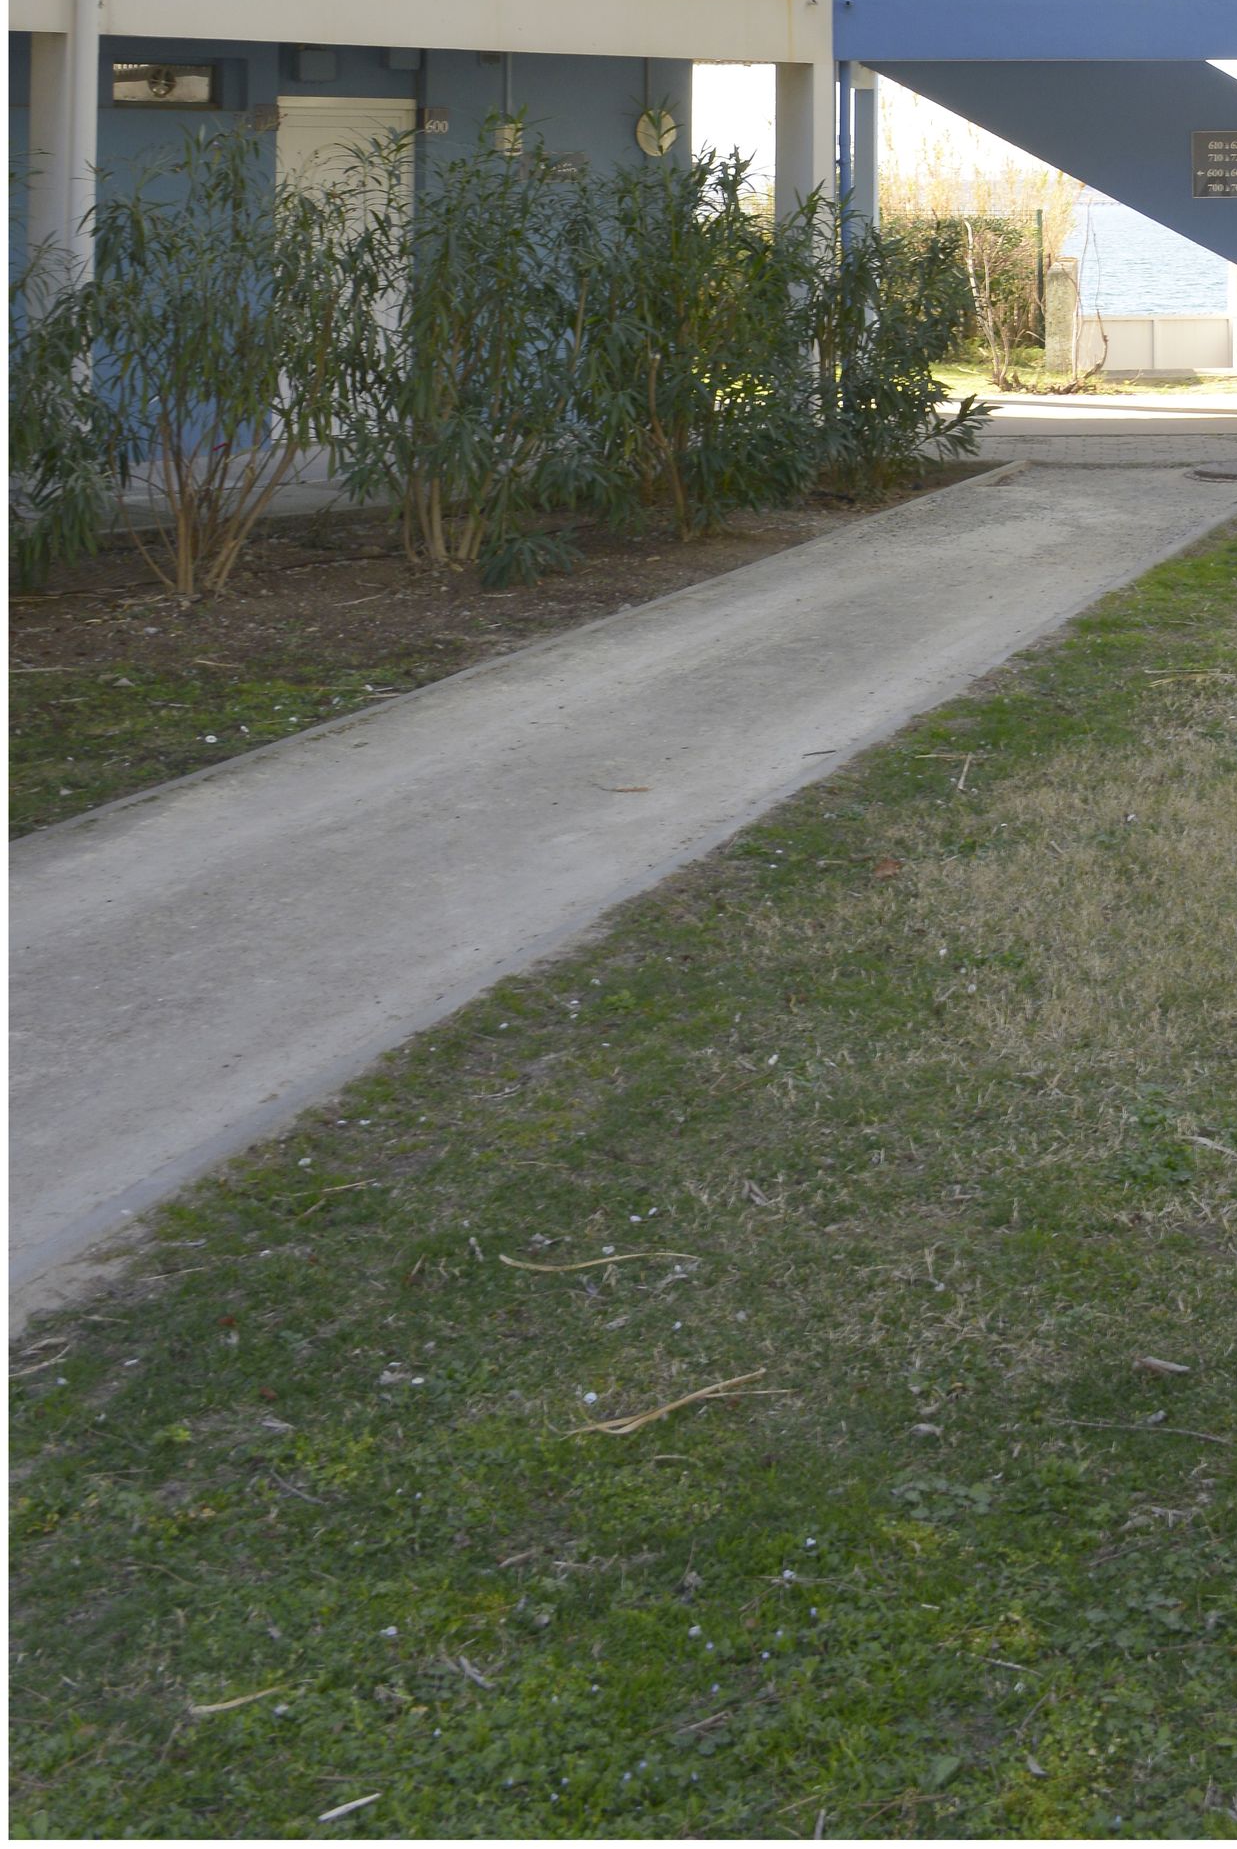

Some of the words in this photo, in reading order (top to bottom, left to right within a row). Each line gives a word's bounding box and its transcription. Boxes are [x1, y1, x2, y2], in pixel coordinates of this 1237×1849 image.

[1208, 141, 1224, 150] 610
[1207, 153, 1224, 162] 710
[1206, 169, 1224, 177] 600
[1207, 183, 1224, 192] 700
